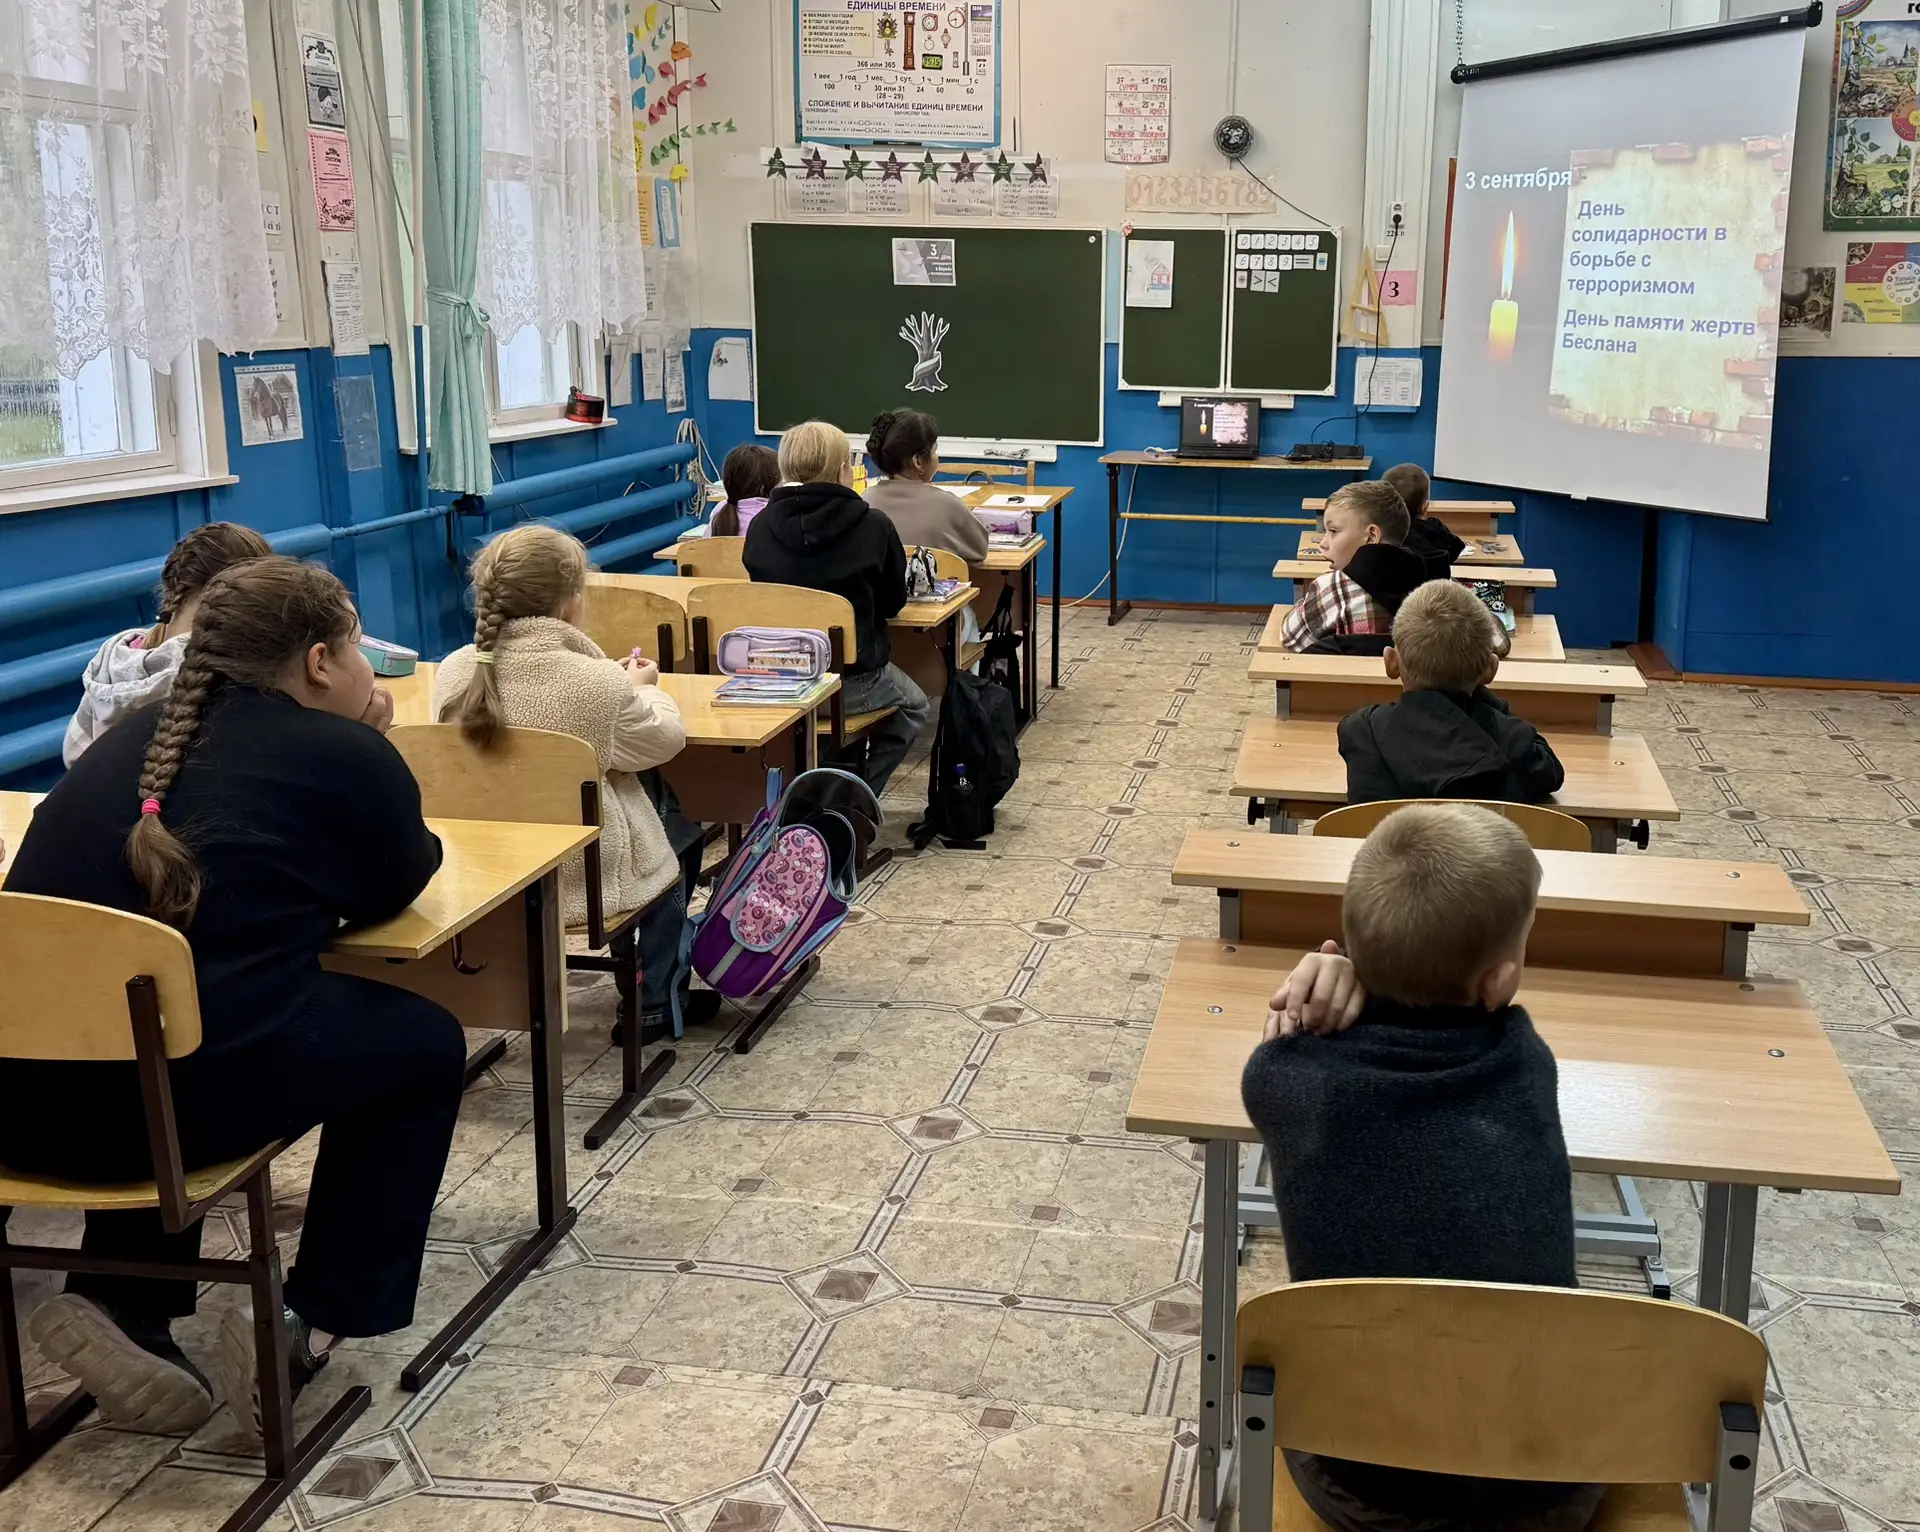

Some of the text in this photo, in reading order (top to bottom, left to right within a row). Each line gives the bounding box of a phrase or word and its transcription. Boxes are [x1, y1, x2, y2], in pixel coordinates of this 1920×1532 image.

[848, 1, 946, 11] ЕДИНИЦЫ ВРЕМЕНИ
[1464, 167, 1572, 191] 3 сентября
[1578, 200, 1625, 220] День
[1241, 236, 1316, 247] 0 1 2 3 4 5
[1572, 227, 1727, 245] солидарности в
[930, 244, 937, 256] 3
[1240, 256, 1245, 266] 6
[1254, 256, 1259, 266] 7
[1268, 257, 1274, 266] 8
[1283, 257, 1288, 267] 9
[1570, 251, 1652, 270] борьбе с
[1388, 281, 1399, 297] 3
[1567, 278, 1695, 296] терроризмом
[1563, 309, 1756, 338] День памяти жертв
[1562, 333, 1637, 354] Беслана
